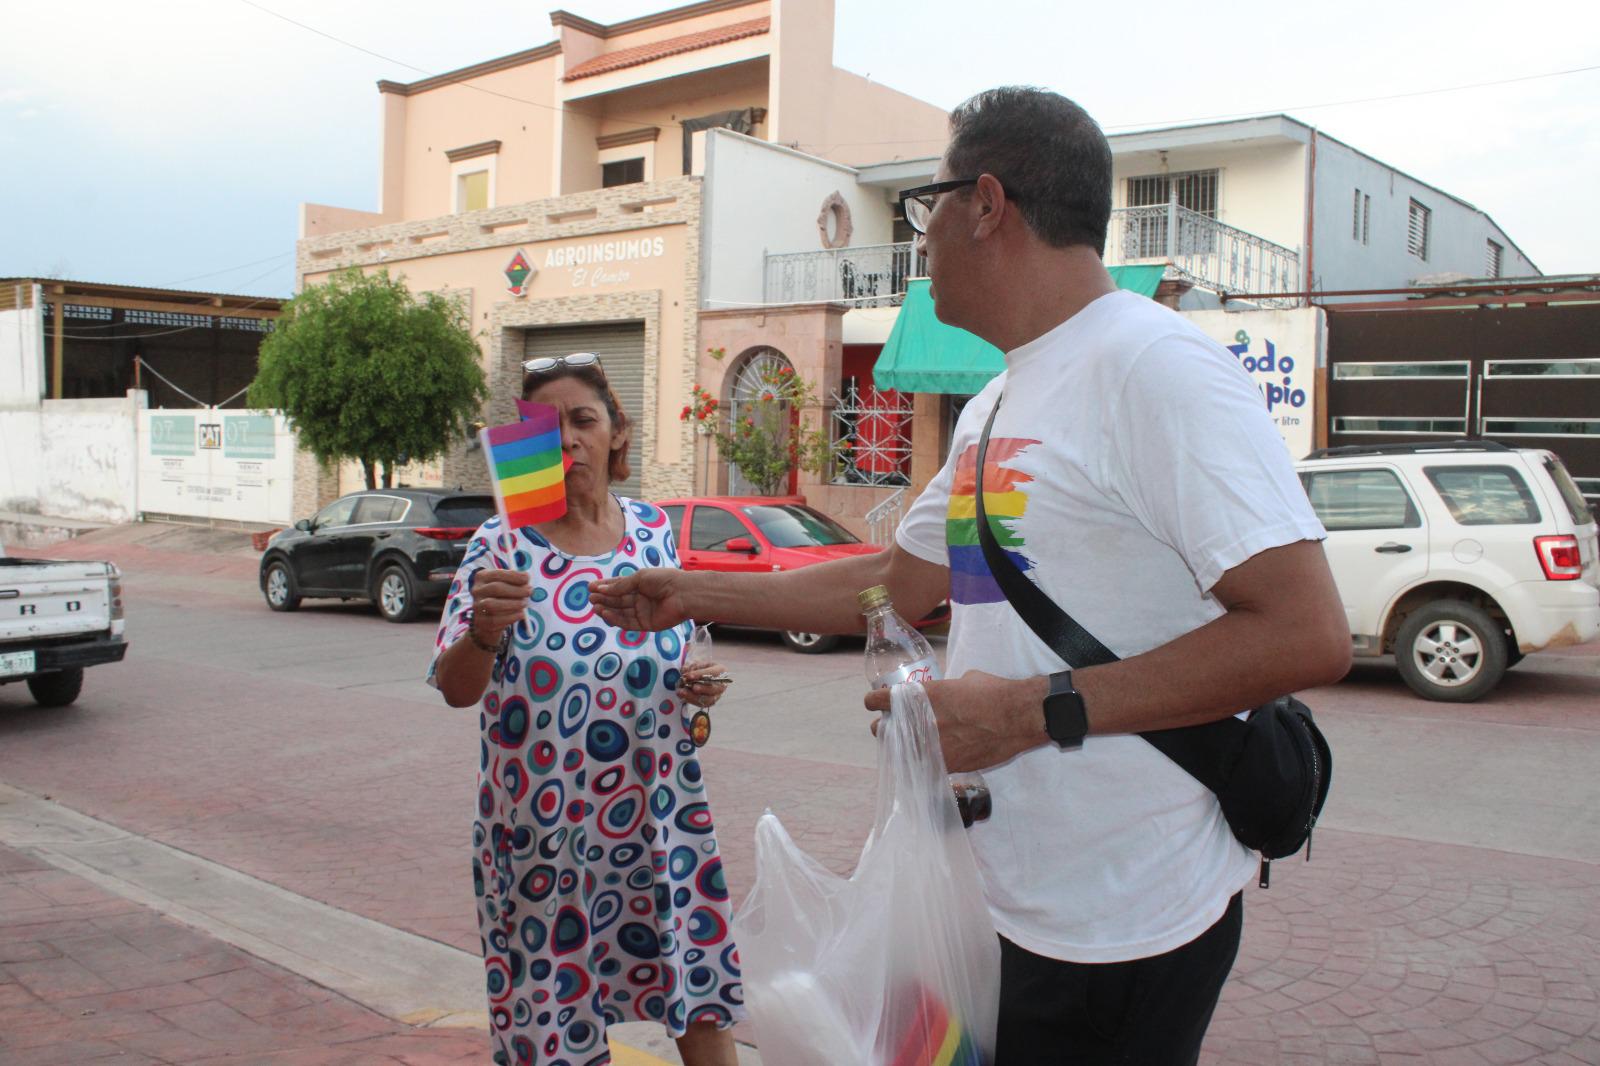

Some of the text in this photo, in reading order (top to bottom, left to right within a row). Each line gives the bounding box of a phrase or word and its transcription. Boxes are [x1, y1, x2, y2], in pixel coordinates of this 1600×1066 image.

[544, 236, 665, 268] AGROINSUMOS
[1258, 376, 1306, 413] pio
[200, 425, 221, 447] CAT
